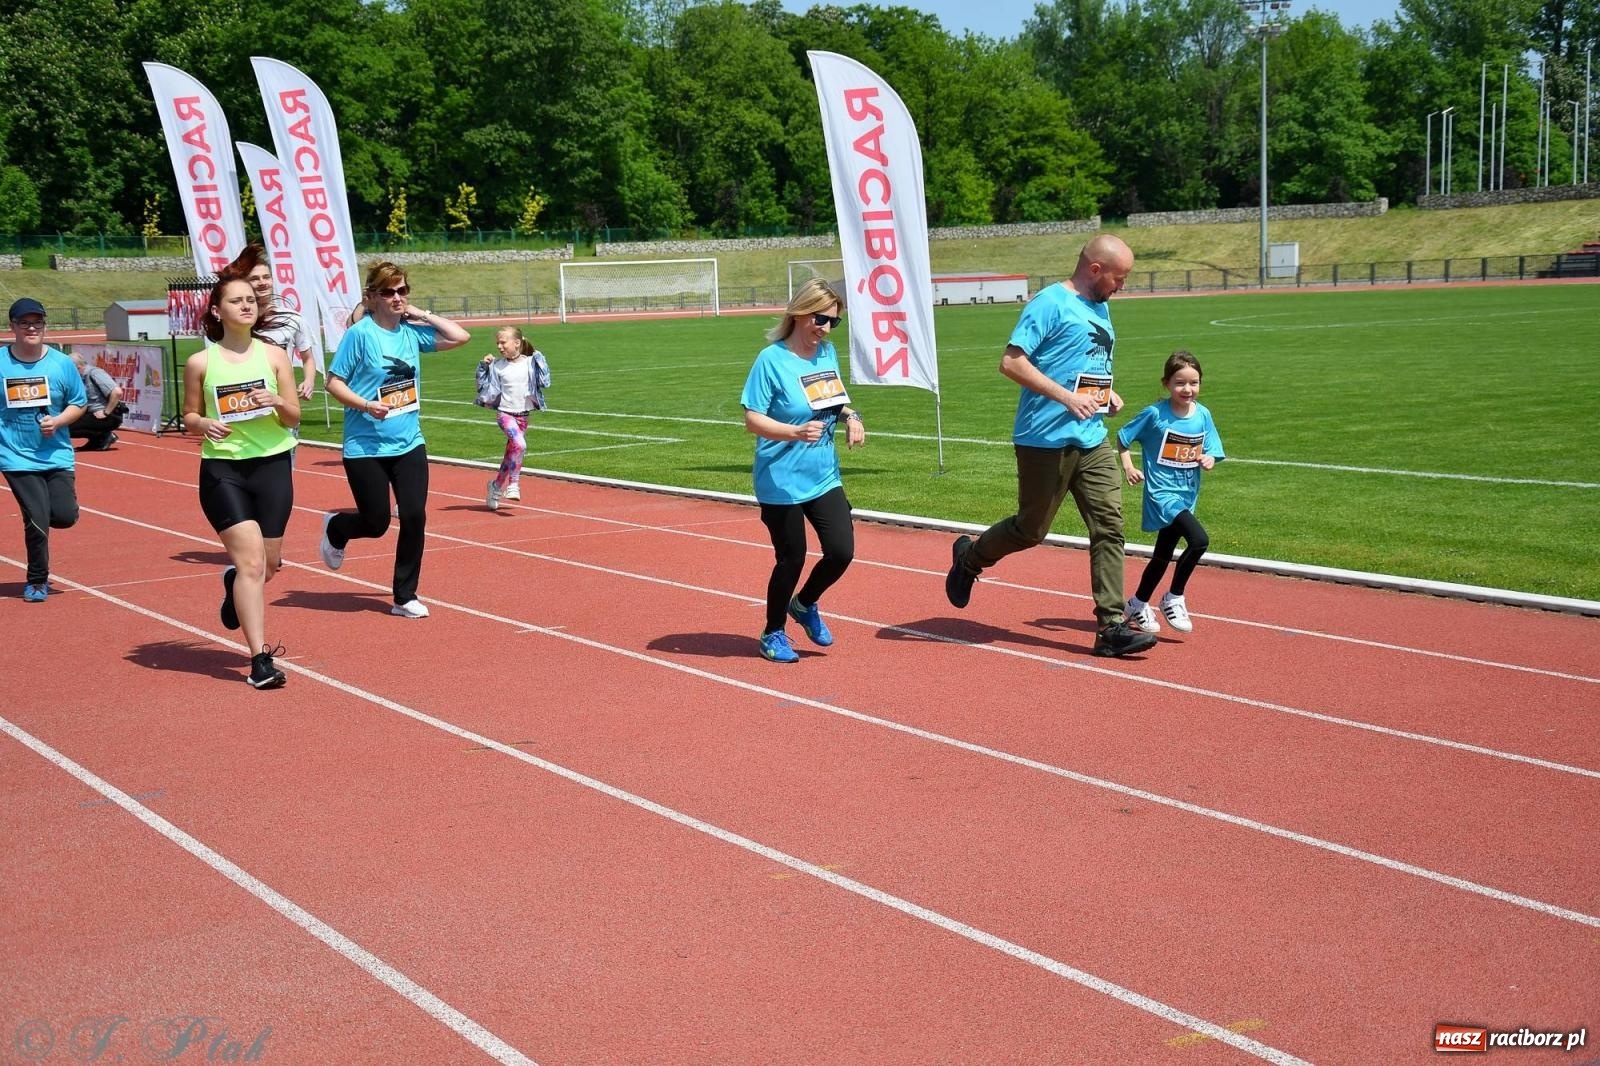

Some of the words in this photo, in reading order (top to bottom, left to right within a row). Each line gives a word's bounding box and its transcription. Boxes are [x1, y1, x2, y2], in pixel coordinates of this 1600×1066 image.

[15, 385, 39, 398] 130
[814, 380, 839, 397] 142
[390, 390, 410, 406] 074
[1174, 445, 1197, 460] 135
